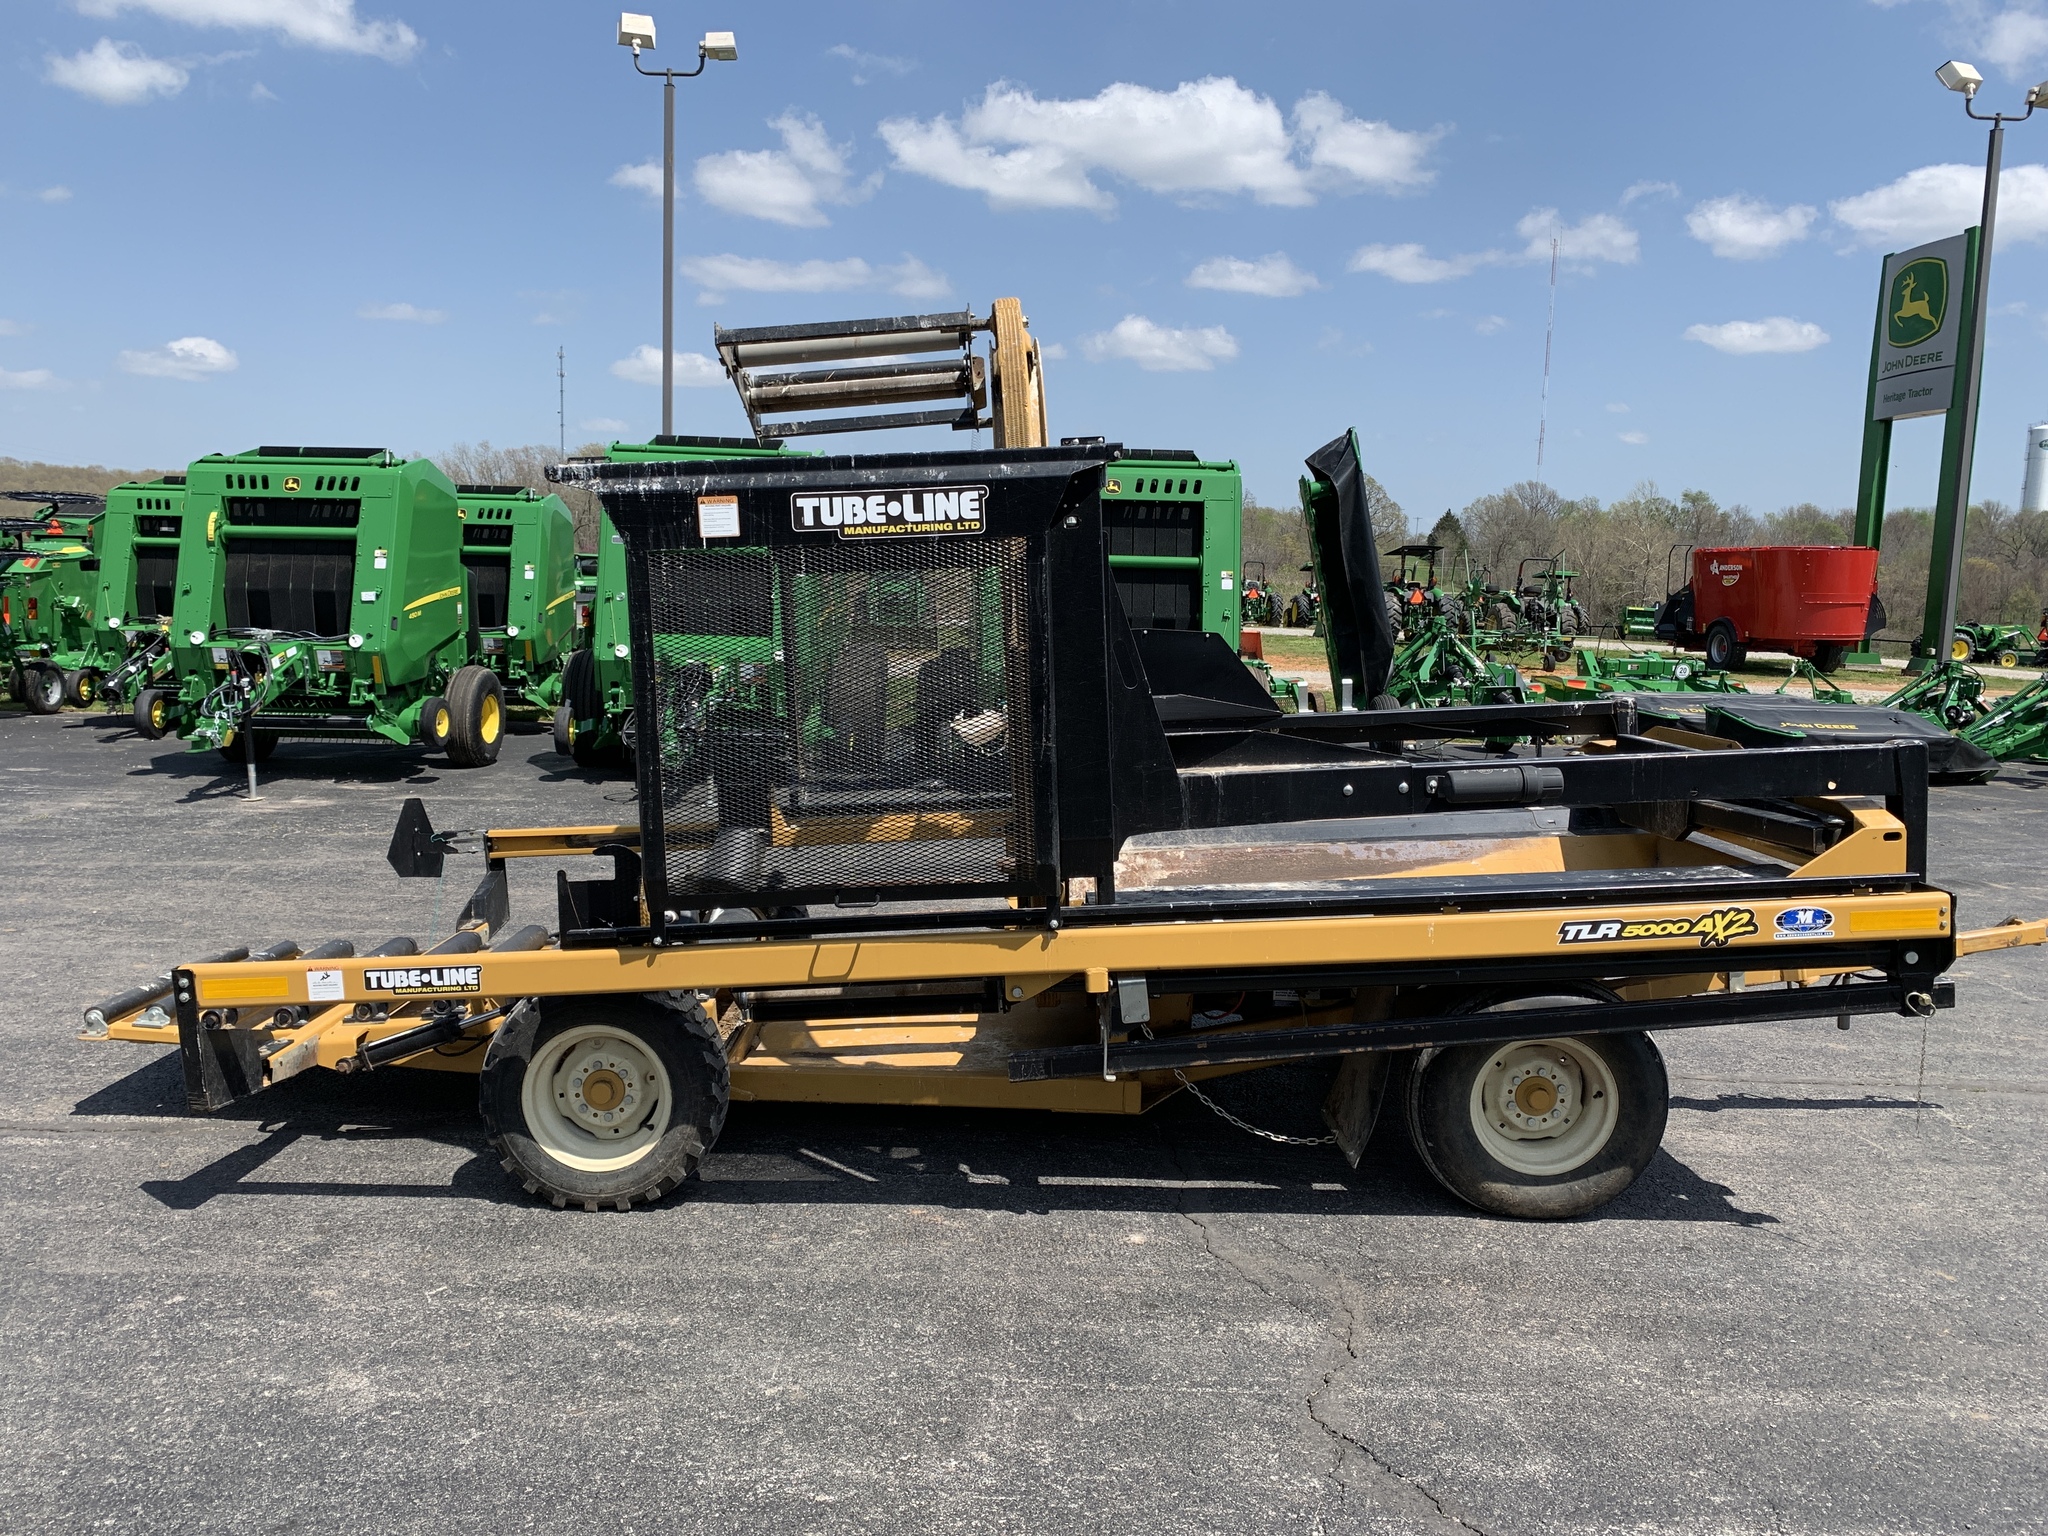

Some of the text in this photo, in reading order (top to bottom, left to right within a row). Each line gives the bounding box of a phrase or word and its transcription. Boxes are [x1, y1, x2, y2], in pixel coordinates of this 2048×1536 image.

[1882, 351, 1943, 373] JOHN DEERE
[1882, 387, 1934, 403] Heritage Tractor
[844, 521, 981, 535] MANUFACTURING LTD
[1564, 923, 1622, 941] TLR
[1621, 922, 1690, 937] 5000
[395, 986, 462, 994] MANUFACTURING
